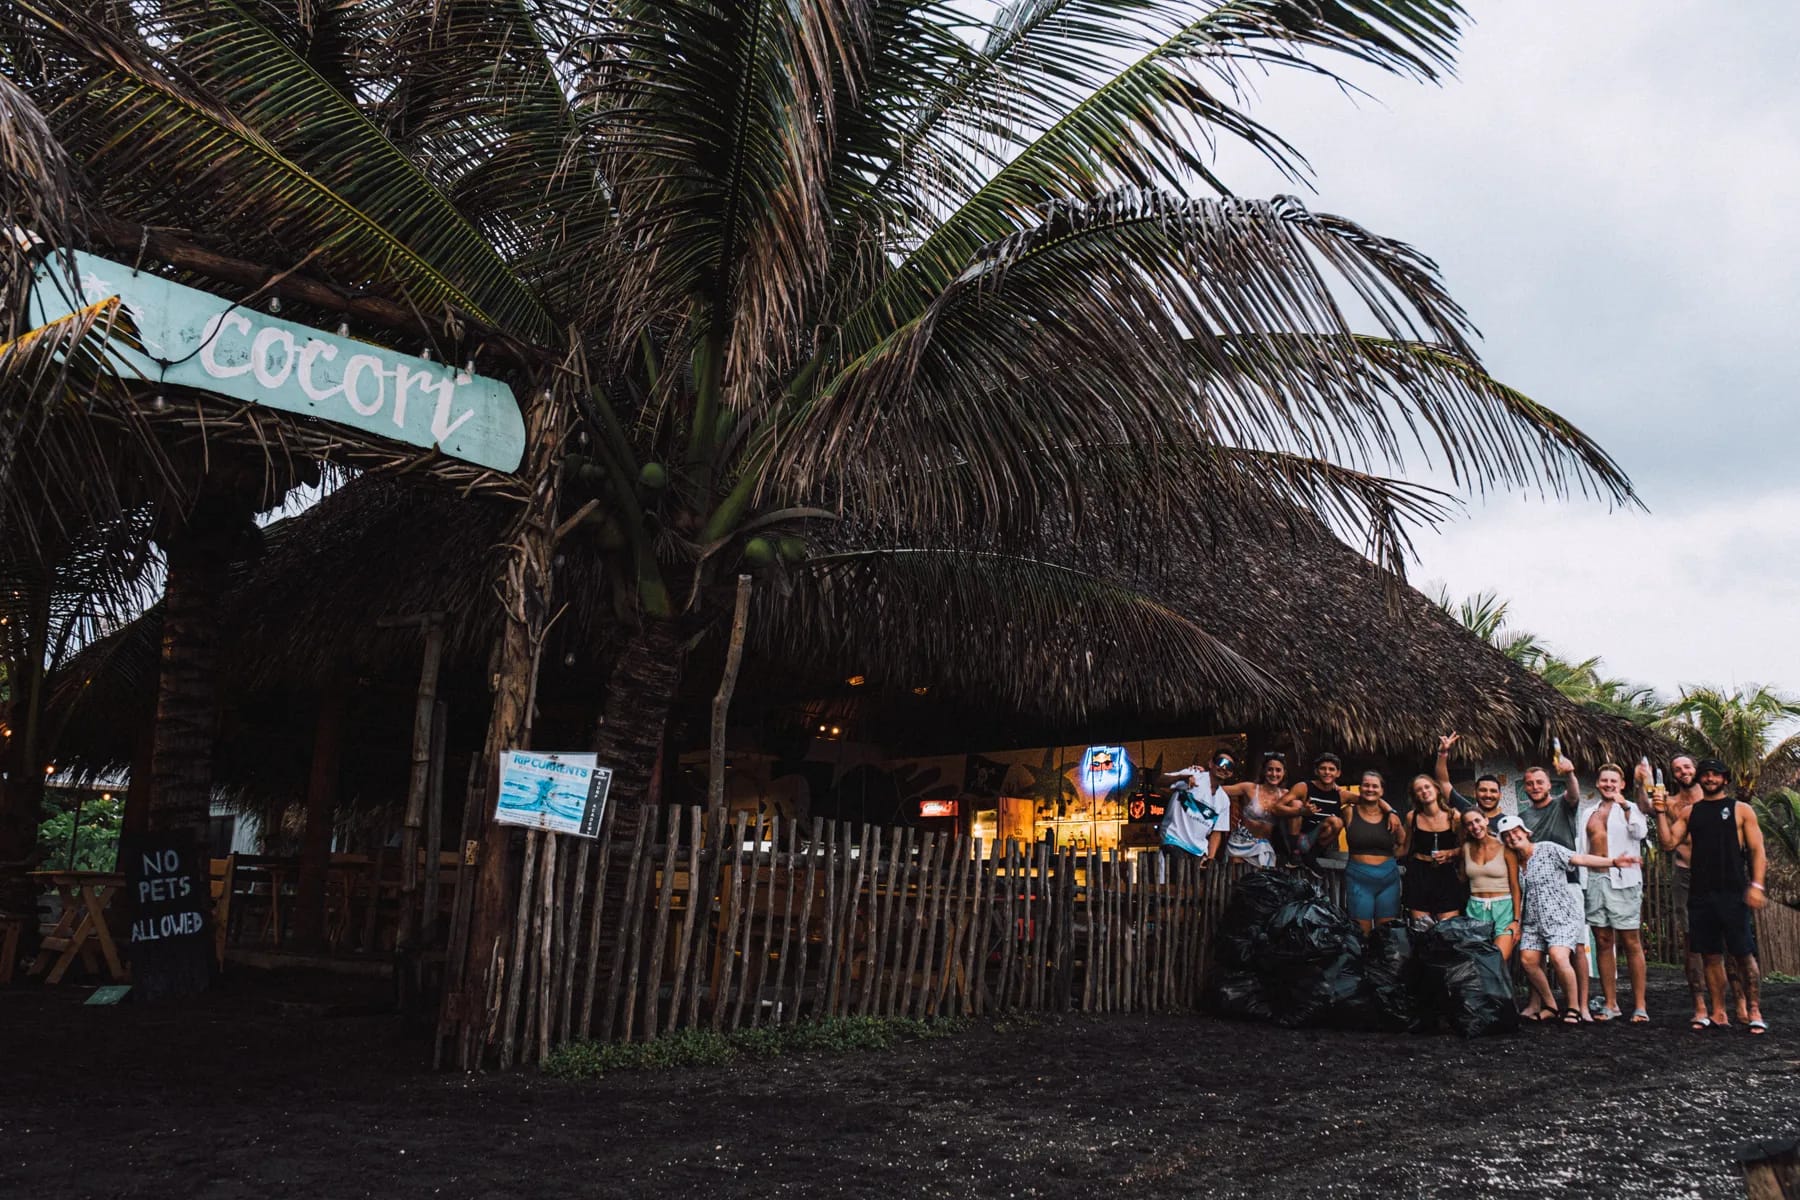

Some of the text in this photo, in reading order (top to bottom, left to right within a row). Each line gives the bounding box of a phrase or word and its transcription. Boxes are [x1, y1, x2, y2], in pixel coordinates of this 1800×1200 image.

[531, 758, 588, 777] CURRENTS
[142, 849, 179, 876] NO
[138, 876, 191, 903] PETS
[131, 911, 203, 943] ALLOWED
